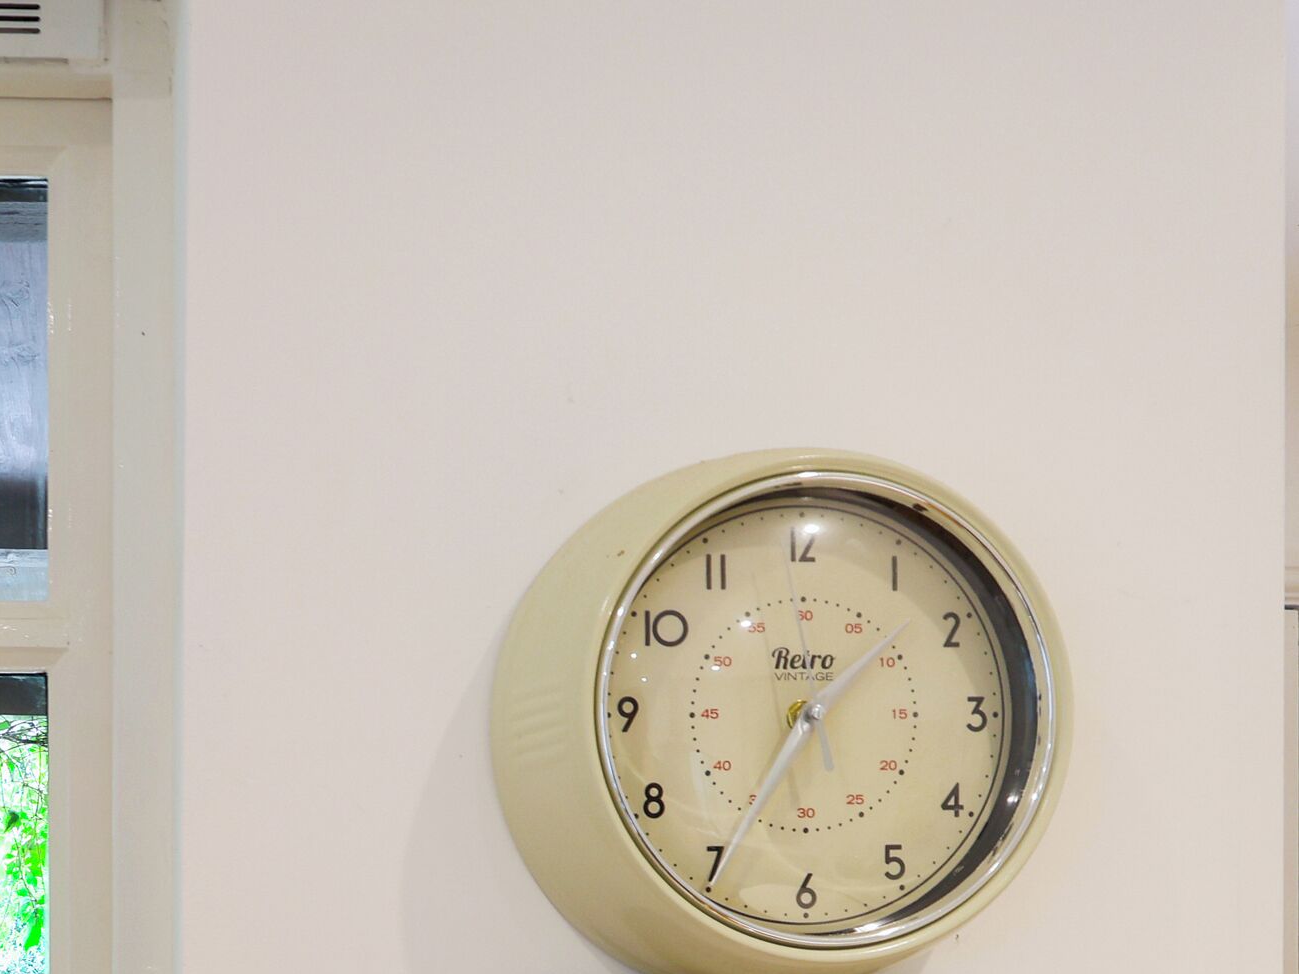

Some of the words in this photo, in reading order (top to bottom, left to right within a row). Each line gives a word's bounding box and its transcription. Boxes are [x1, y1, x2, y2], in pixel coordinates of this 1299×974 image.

[790, 527, 816, 562] 12
[706, 554, 727, 590] 11
[891, 556, 898, 591] 1
[644, 609, 689, 646] 10
[748, 623, 765, 633] 55
[845, 623, 862, 634] 05
[942, 612, 961, 647] 2
[714, 656, 732, 667] 50
[771, 647, 836, 670] Retro
[880, 657, 895, 668] 10
[617, 696, 639, 732] 9
[701, 709, 719, 719] 45
[892, 709, 908, 719] 15
[966, 696, 988, 731] 3
[713, 760, 731, 771] 40
[880, 760, 897, 771] 20
[642, 783, 664, 819] 8
[797, 808, 815, 818] 30
[846, 794, 864, 805] 25
[941, 783, 964, 818] 4
[706, 846, 724, 884] 7
[885, 845, 906, 880] 5
[796, 873, 816, 909] 6
